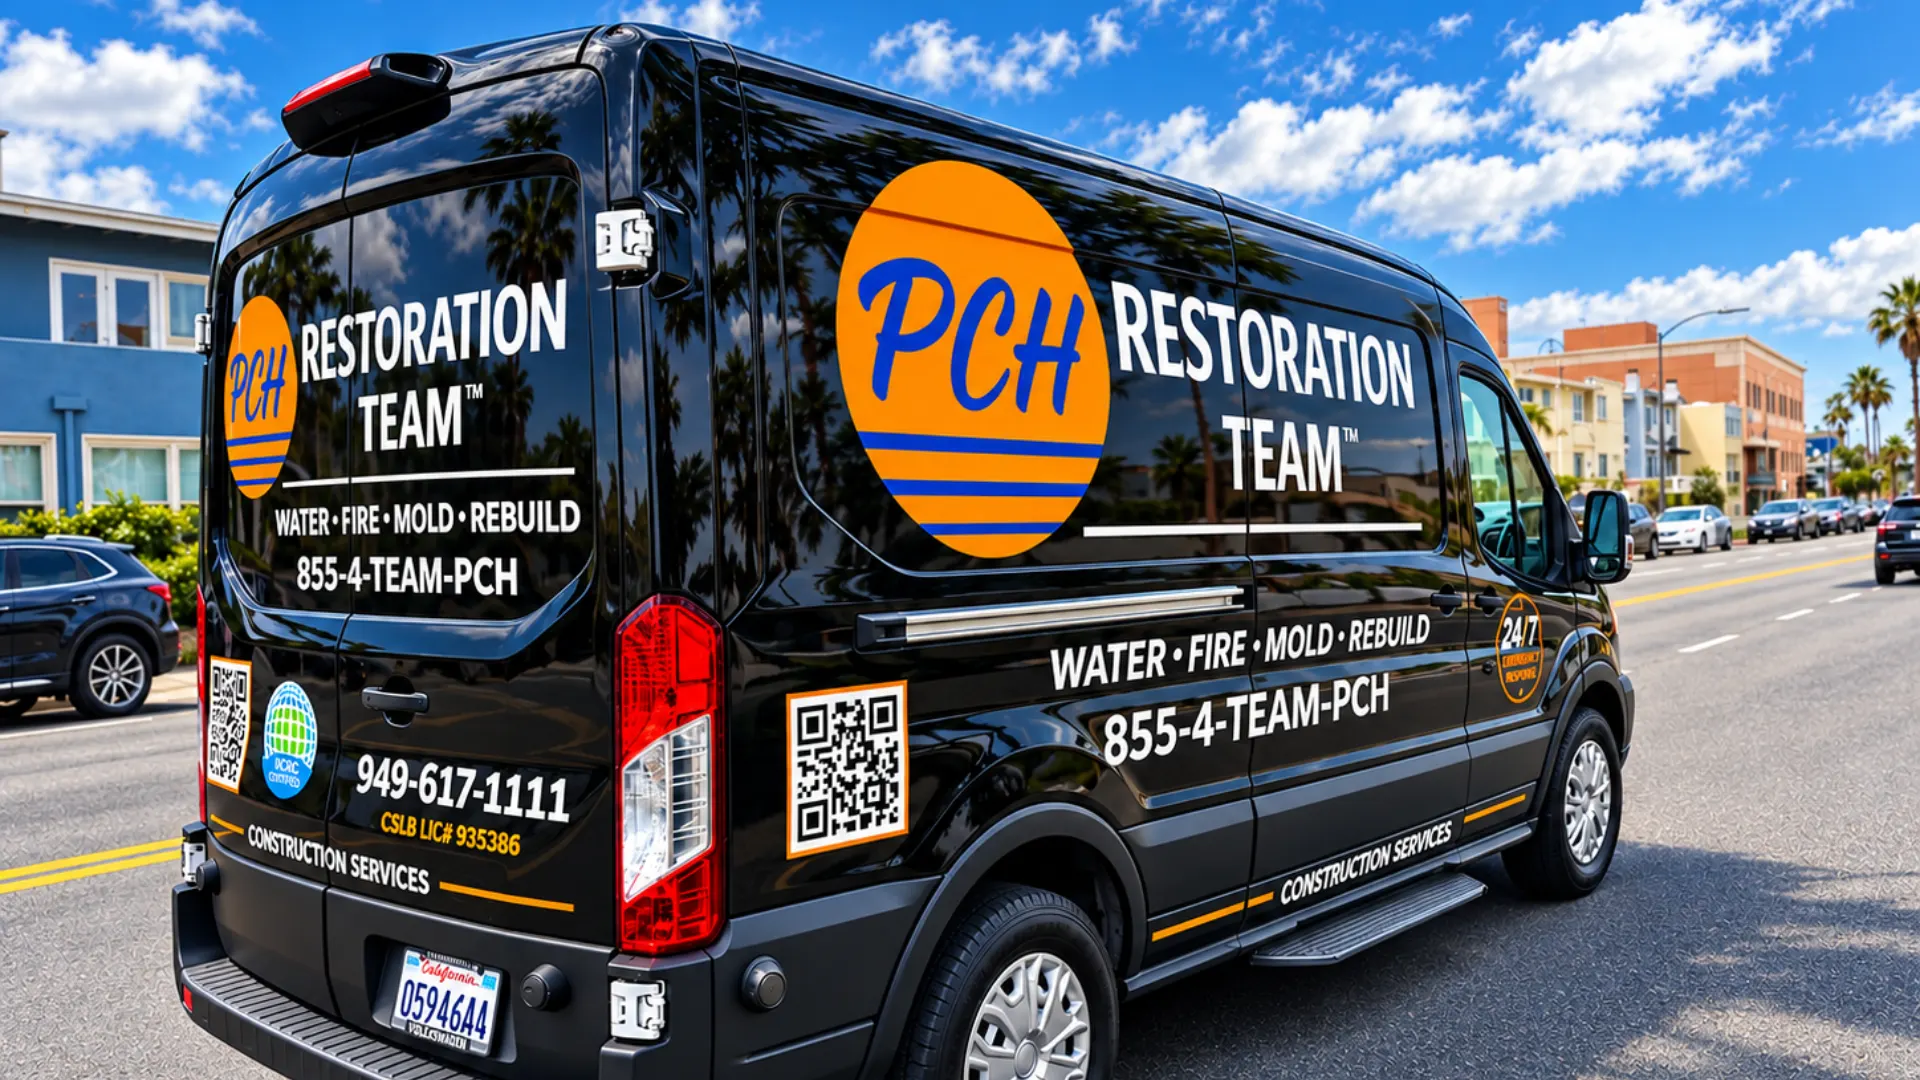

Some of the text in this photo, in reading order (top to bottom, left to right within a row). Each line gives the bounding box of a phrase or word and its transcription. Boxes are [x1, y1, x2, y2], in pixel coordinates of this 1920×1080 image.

[301, 278, 567, 383] RESTORATION
[859, 257, 1085, 416] PCH
[1111, 280, 1416, 408] RESTORATION
[229, 344, 288, 423] PCH
[274, 499, 582, 536] WATER FIRE MOLD REBUILD
[296, 555, 518, 596] 855-4-TEAM-PCH
[1050, 613, 1430, 691] WATER FIRE MOLD REBUILD
[1501, 614, 1538, 650] 24/7
[1103, 672, 1390, 767] 855-4-TEAM-PCH
[355, 754, 570, 823] 949-617-1111
[248, 823, 430, 896] CONSTRUCTION SERVICES
[380, 811, 521, 857] CSLB LIC# 935386
[1280, 819, 1453, 905] CONSTRUCTION SERVICES
[420, 958, 479, 987] California
